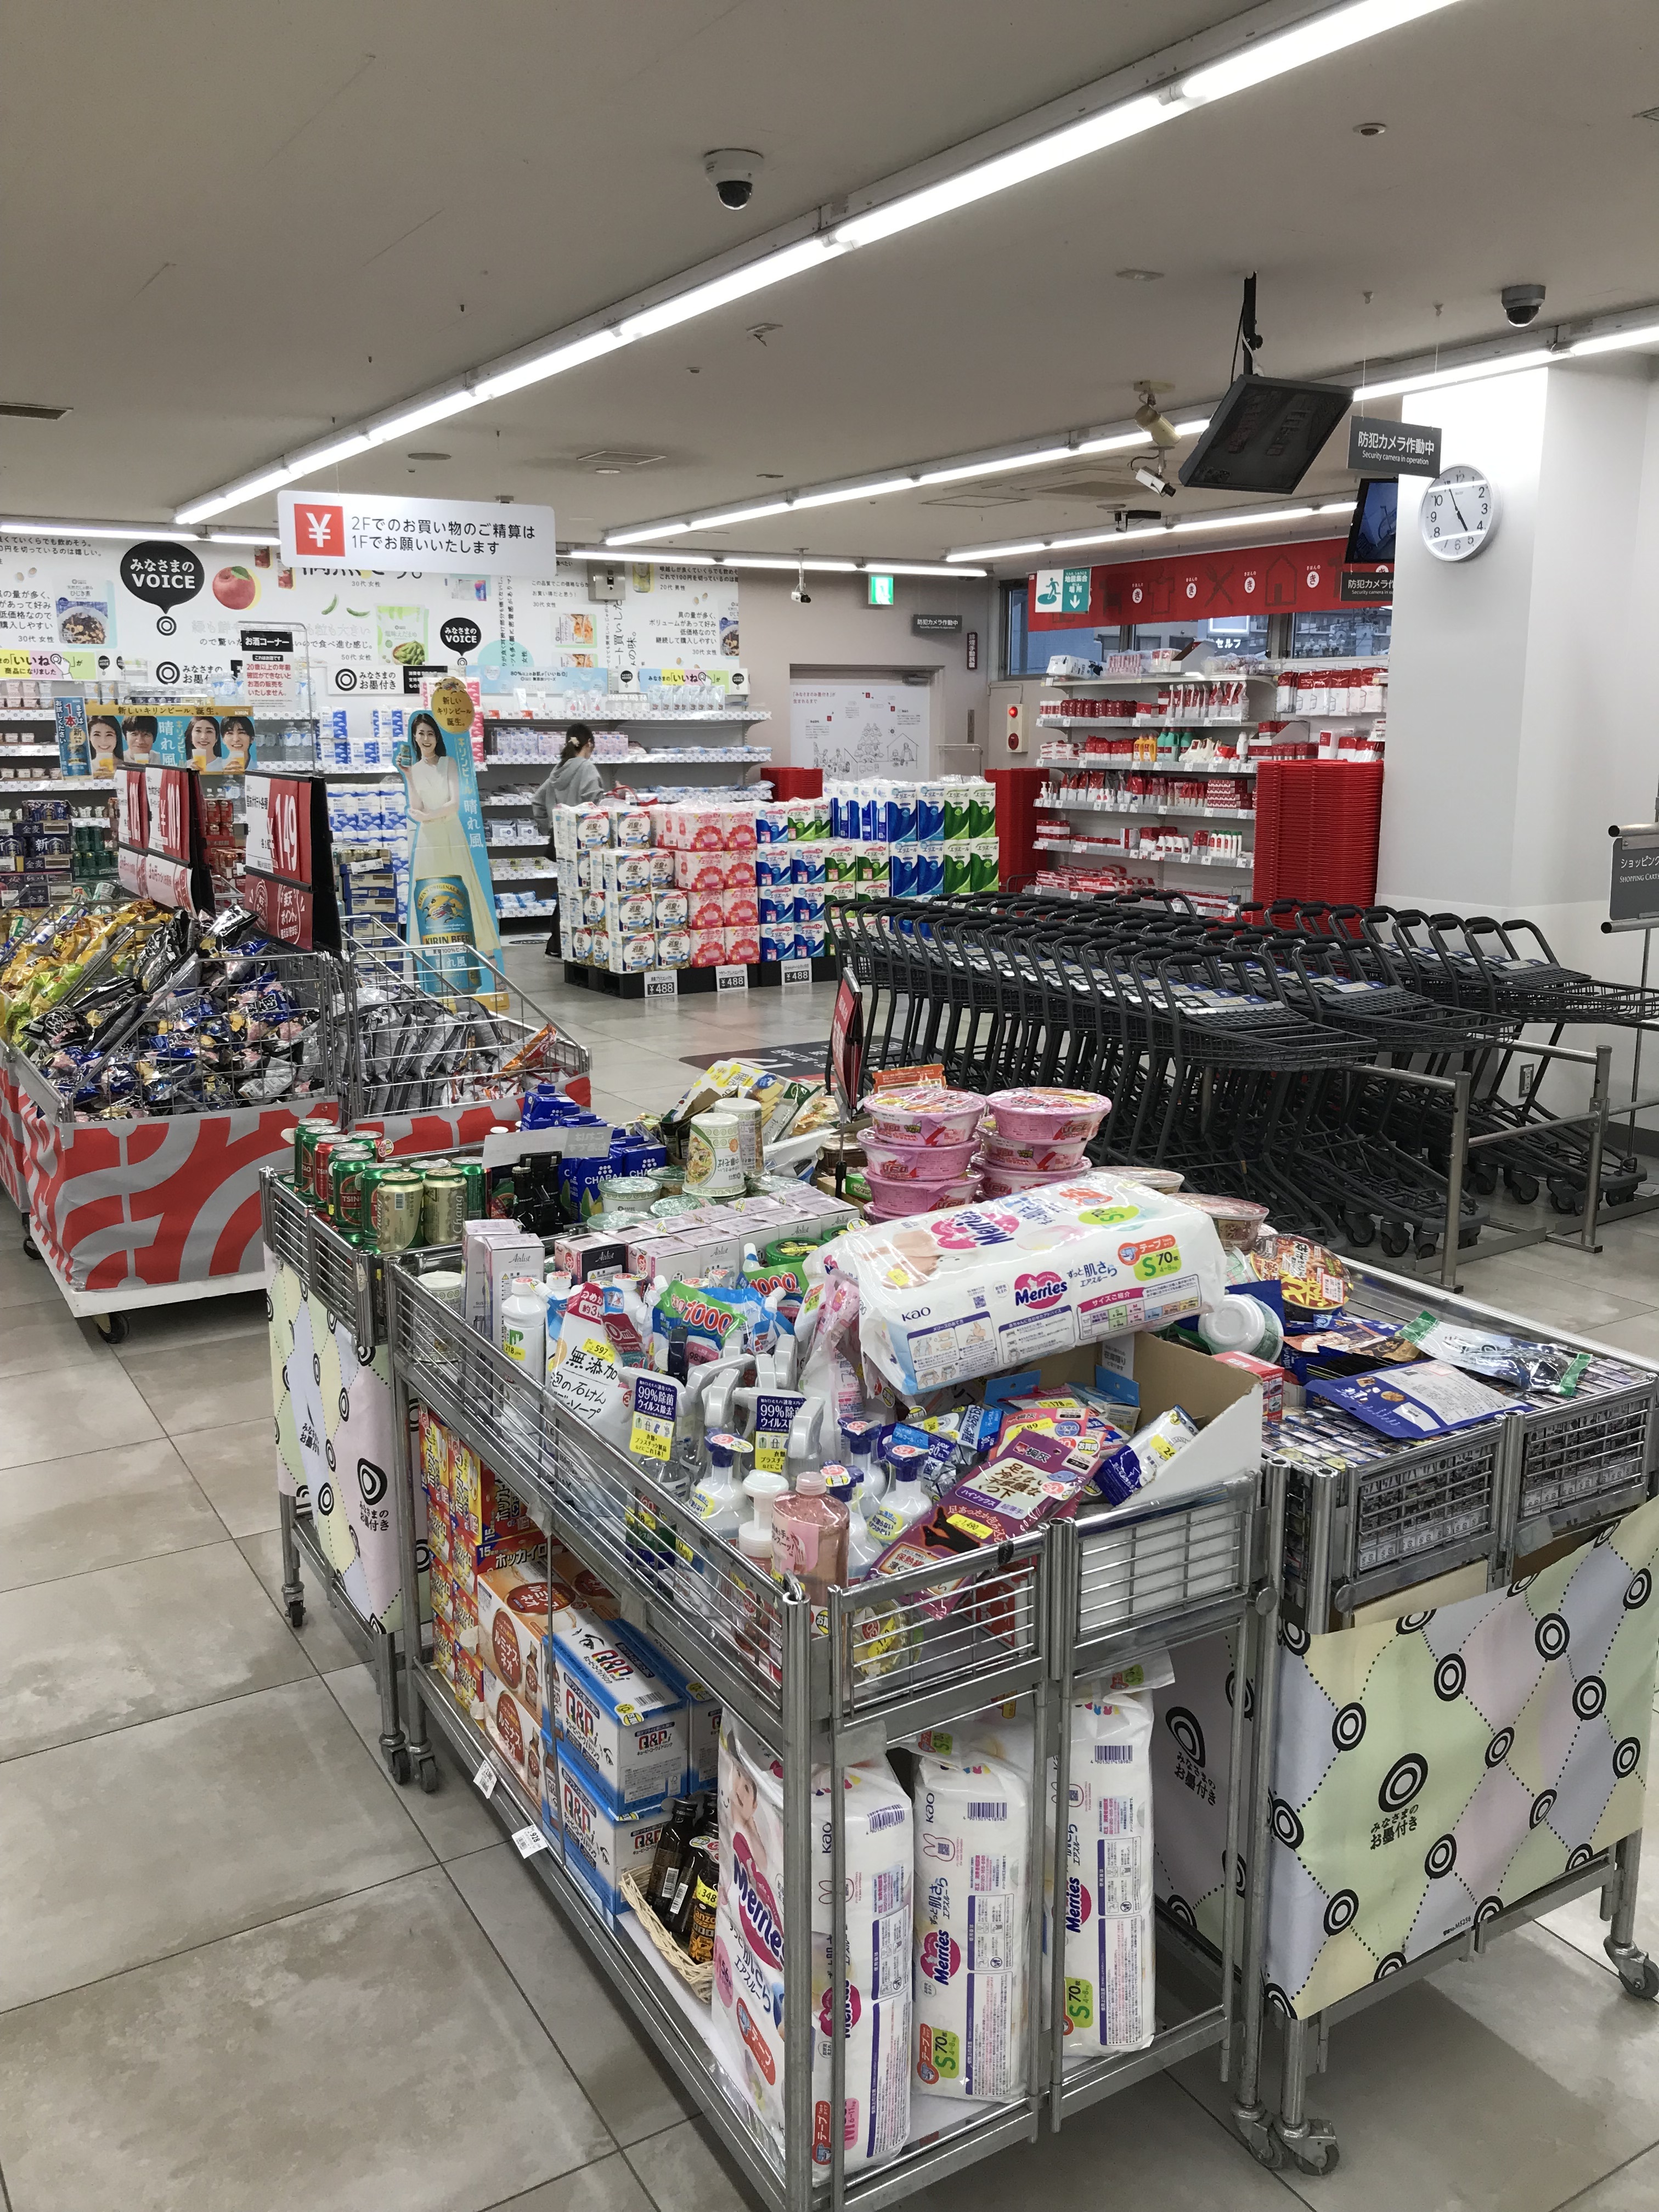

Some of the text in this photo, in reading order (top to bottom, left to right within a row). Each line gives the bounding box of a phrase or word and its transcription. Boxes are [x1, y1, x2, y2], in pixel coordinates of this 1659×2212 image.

[1358, 431, 1435, 455] 防犯カメラ作動中
[1362, 450, 1381, 460] Security
[1383, 454, 1400, 462] camera
[1407, 456, 1429, 465] operation
[1479, 487, 1485, 498] 2
[1434, 495, 1443, 506] 10
[1430, 511, 1437, 522] 9
[1481, 503, 1488, 515] 3
[351, 516, 535, 539] 2Fでのお買い物のご精算は
[1434, 527, 1440, 538] 8
[1477, 521, 1483, 531] 4
[352, 534, 499, 555] 1Fでお願いいたします
[130, 558, 194, 573] みなさまの
[132, 573, 195, 589] VOICE
[1246, 579, 1253, 591] き
[1310, 574, 1317, 585] き
[1188, 585, 1194, 596] き
[445, 635, 477, 644] VOICE
[680, 628, 716, 636] 低価格なので
[245, 636, 290, 647] お酒コーナー
[1215, 639, 1242, 649] セルフ
[5, 667, 57, 675] 商品になりました
[182, 665, 223, 673] みなさまの
[359, 680, 397, 690] お墨付き
[442, 696, 461, 705] 新しい
[117, 706, 219, 715] 新しいキリンビール、誕生。
[437, 707, 472, 715] キリンビール
[159, 721, 177, 767] 晴れ風
[22, 825, 40, 833] 金麦
[464, 799, 484, 848] 晴れ風
[35, 838, 48, 851] 新
[26, 860, 43, 868] 金麦
[425, 934, 471, 945] KIRIN BEER
[452, 1195, 464, 1234] Chang
[1139, 1238, 1161, 1253] テープ
[595, 1250, 615, 1262] Airlist
[1066, 1260, 1118, 1279] ずっと肌さら
[1142, 1256, 1156, 1277] S
[1080, 1276, 1108, 1288] エアスルー
[1014, 1279, 1068, 1307] Merries
[1092, 1291, 1130, 1306] サイズご紹介
[682, 1300, 733, 1335] 1000
[594, 1345, 609, 1356] 597
[566, 1346, 618, 1380] 無添加
[637, 1386, 674, 1406] 99%除菌
[637, 1398, 674, 1416] ウイルス除去
[760, 1417, 792, 1427] ウイルス
[635, 1436, 667, 1452] プラスチック製品
[1025, 1447, 1052, 1463] 桐灰
[1005, 1463, 1033, 1475] 足の
[960, 1488, 994, 1506] ハイソックス
[479, 1545, 492, 1558] 15
[495, 1544, 548, 1568] ホッカイロ
[566, 1689, 594, 1739] Q&P
[639, 1730, 668, 1751] Q&P
[1177, 1751, 1216, 1791] みなさまの
[1174, 1765, 1216, 1806] お墨付き
[1369, 1804, 1420, 1835] みなさまの
[1369, 1815, 1420, 1851] お墨付き
[701, 1889, 716, 1903] 348
[929, 1877, 949, 1926] ずっと肌さら
[1065, 1876, 1081, 1934] Merries
[933, 1929, 950, 1986] Merries
[735, 1954, 761, 2001] エアスルー
[921, 2038, 930, 2061] テープ
[940, 2055, 957, 2071] S
